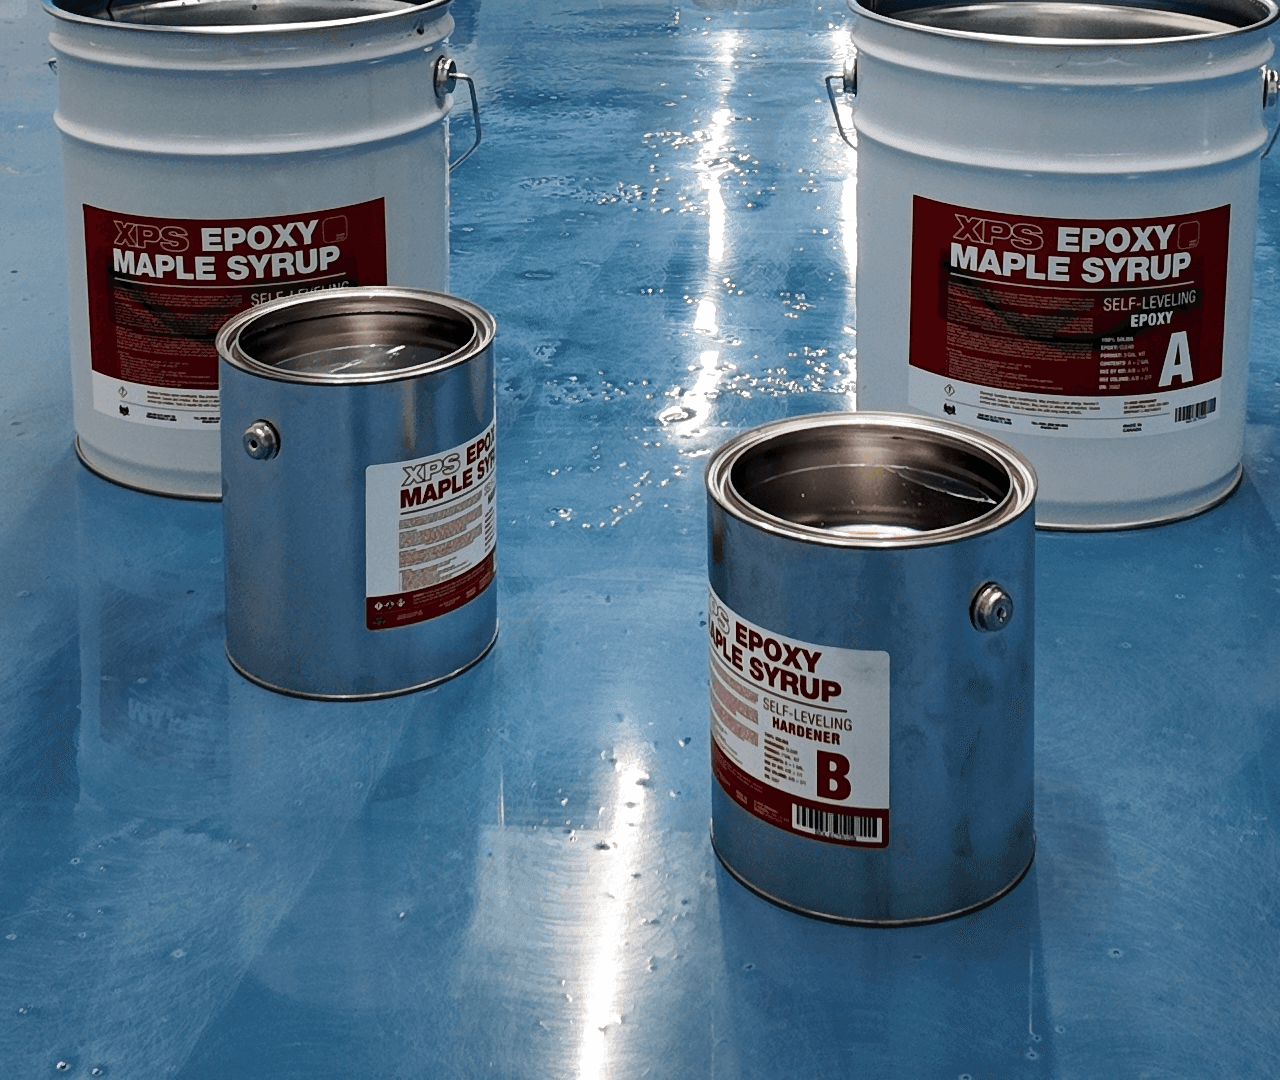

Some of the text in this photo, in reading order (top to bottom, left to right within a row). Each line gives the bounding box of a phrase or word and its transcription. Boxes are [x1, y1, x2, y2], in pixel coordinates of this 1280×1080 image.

[114, 219, 319, 252] XPS EPOXY
[953, 214, 1175, 253] XPS EPOXY
[113, 246, 340, 280] MAPLE SYRUP
[950, 242, 1191, 283] MAPLE SYRUP
[1103, 290, 1197, 312] SELF-LEVELING
[1131, 311, 1173, 328] EPOXY
[1158, 331, 1193, 387] A
[400, 467, 473, 508] MAPLE
[401, 453, 460, 487] XPS
[735, 621, 822, 673] EPOXY
[749, 657, 842, 702] SYRUP
[763, 697, 853, 731] SELF-LEVELING
[772, 716, 840, 745] HARDENER
[816, 749, 851, 801] B
